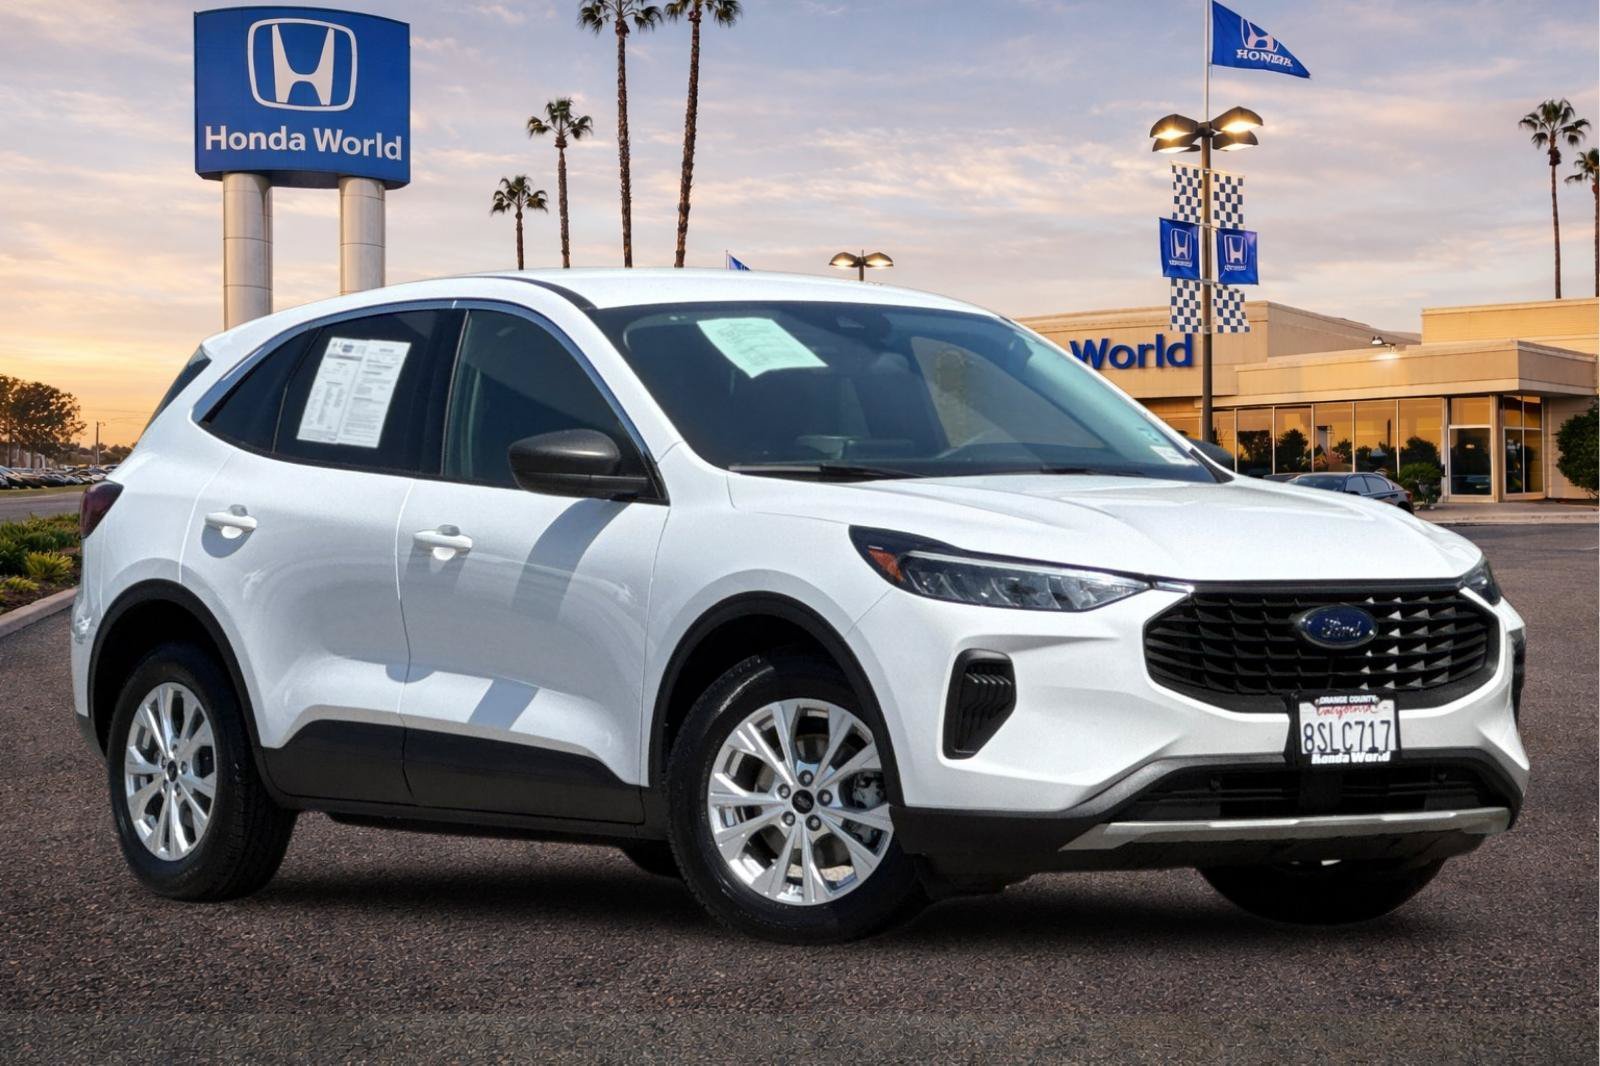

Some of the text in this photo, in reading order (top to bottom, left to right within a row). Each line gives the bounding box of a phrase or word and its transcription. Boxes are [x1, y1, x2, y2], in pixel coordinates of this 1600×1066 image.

[205, 125, 402, 160] Honda World
[1069, 333, 1193, 370] World
[1303, 720, 1391, 753] 8SLC717
[1311, 751, 1391, 764] Honda World
